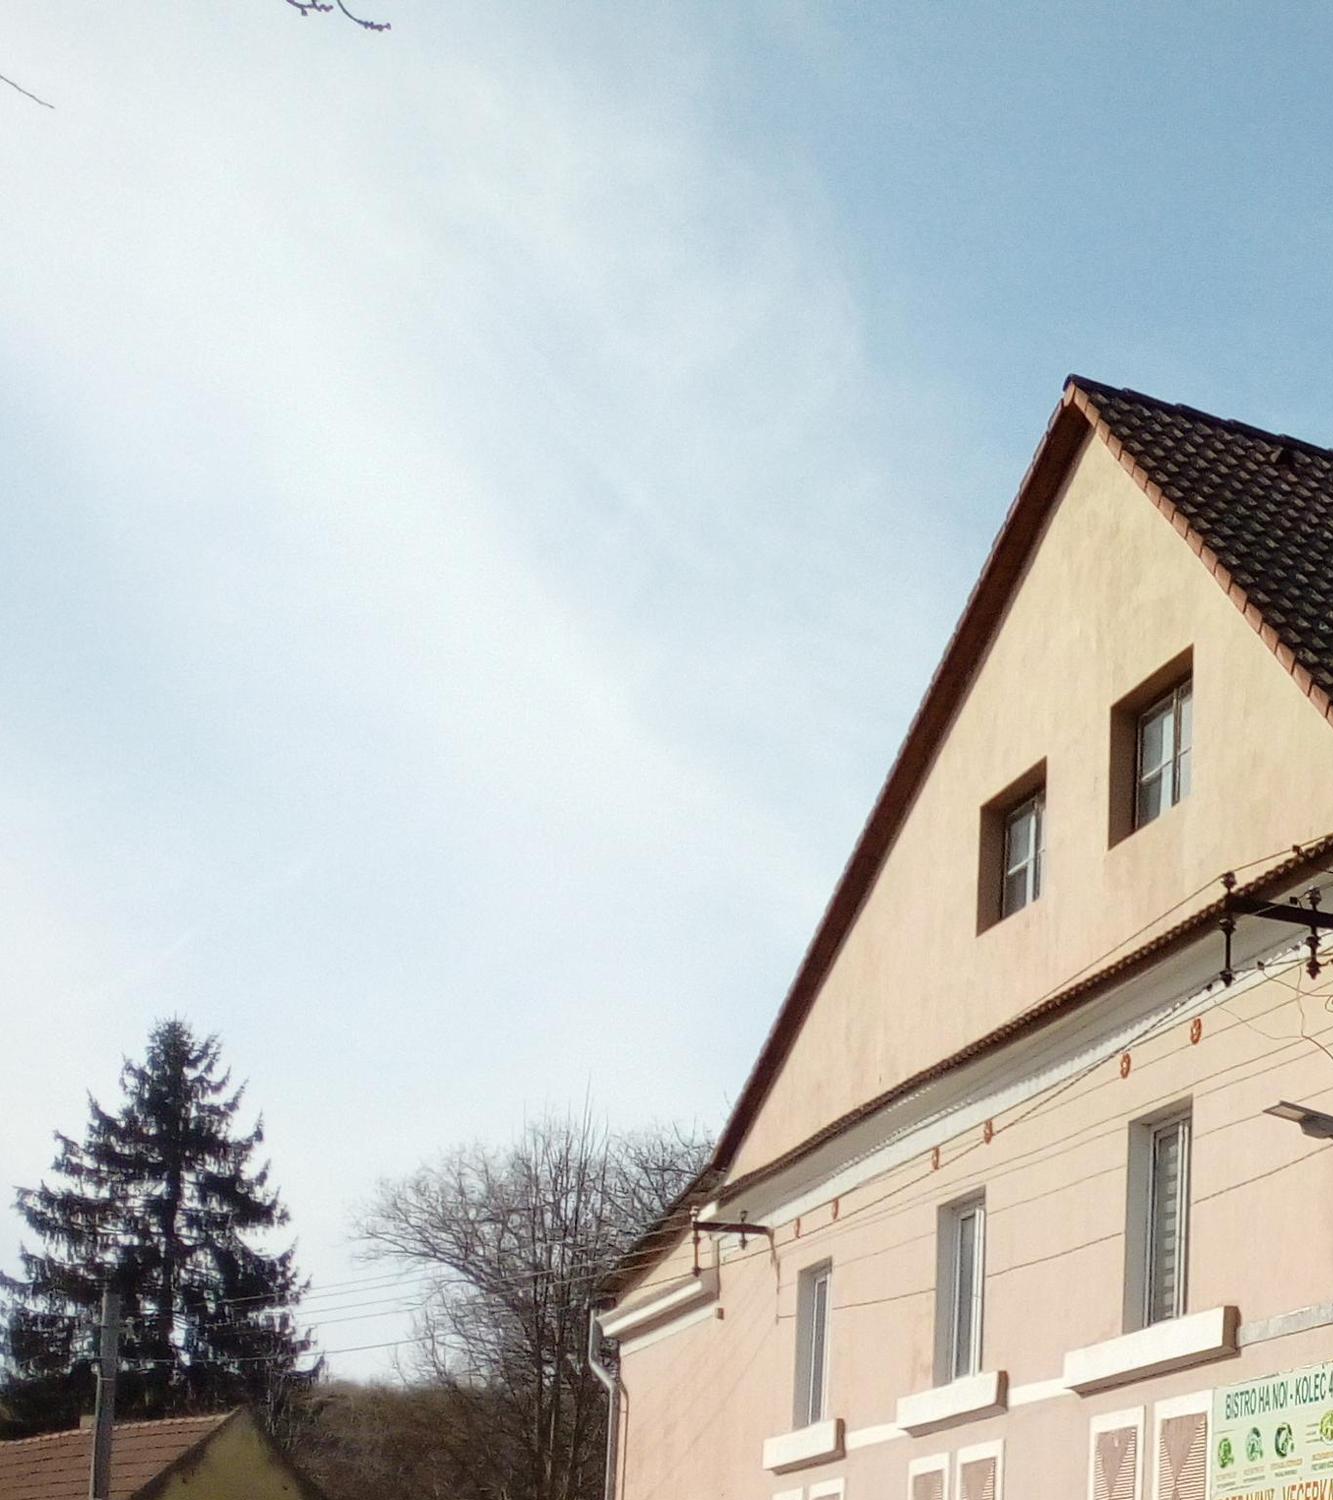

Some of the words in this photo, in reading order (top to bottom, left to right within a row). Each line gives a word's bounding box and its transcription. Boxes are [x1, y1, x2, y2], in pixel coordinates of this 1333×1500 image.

[1225, 1387, 1257, 1420] BISTRO
[1258, 1384, 1271, 1414] HA
[1272, 1380, 1289, 1410] NOI
